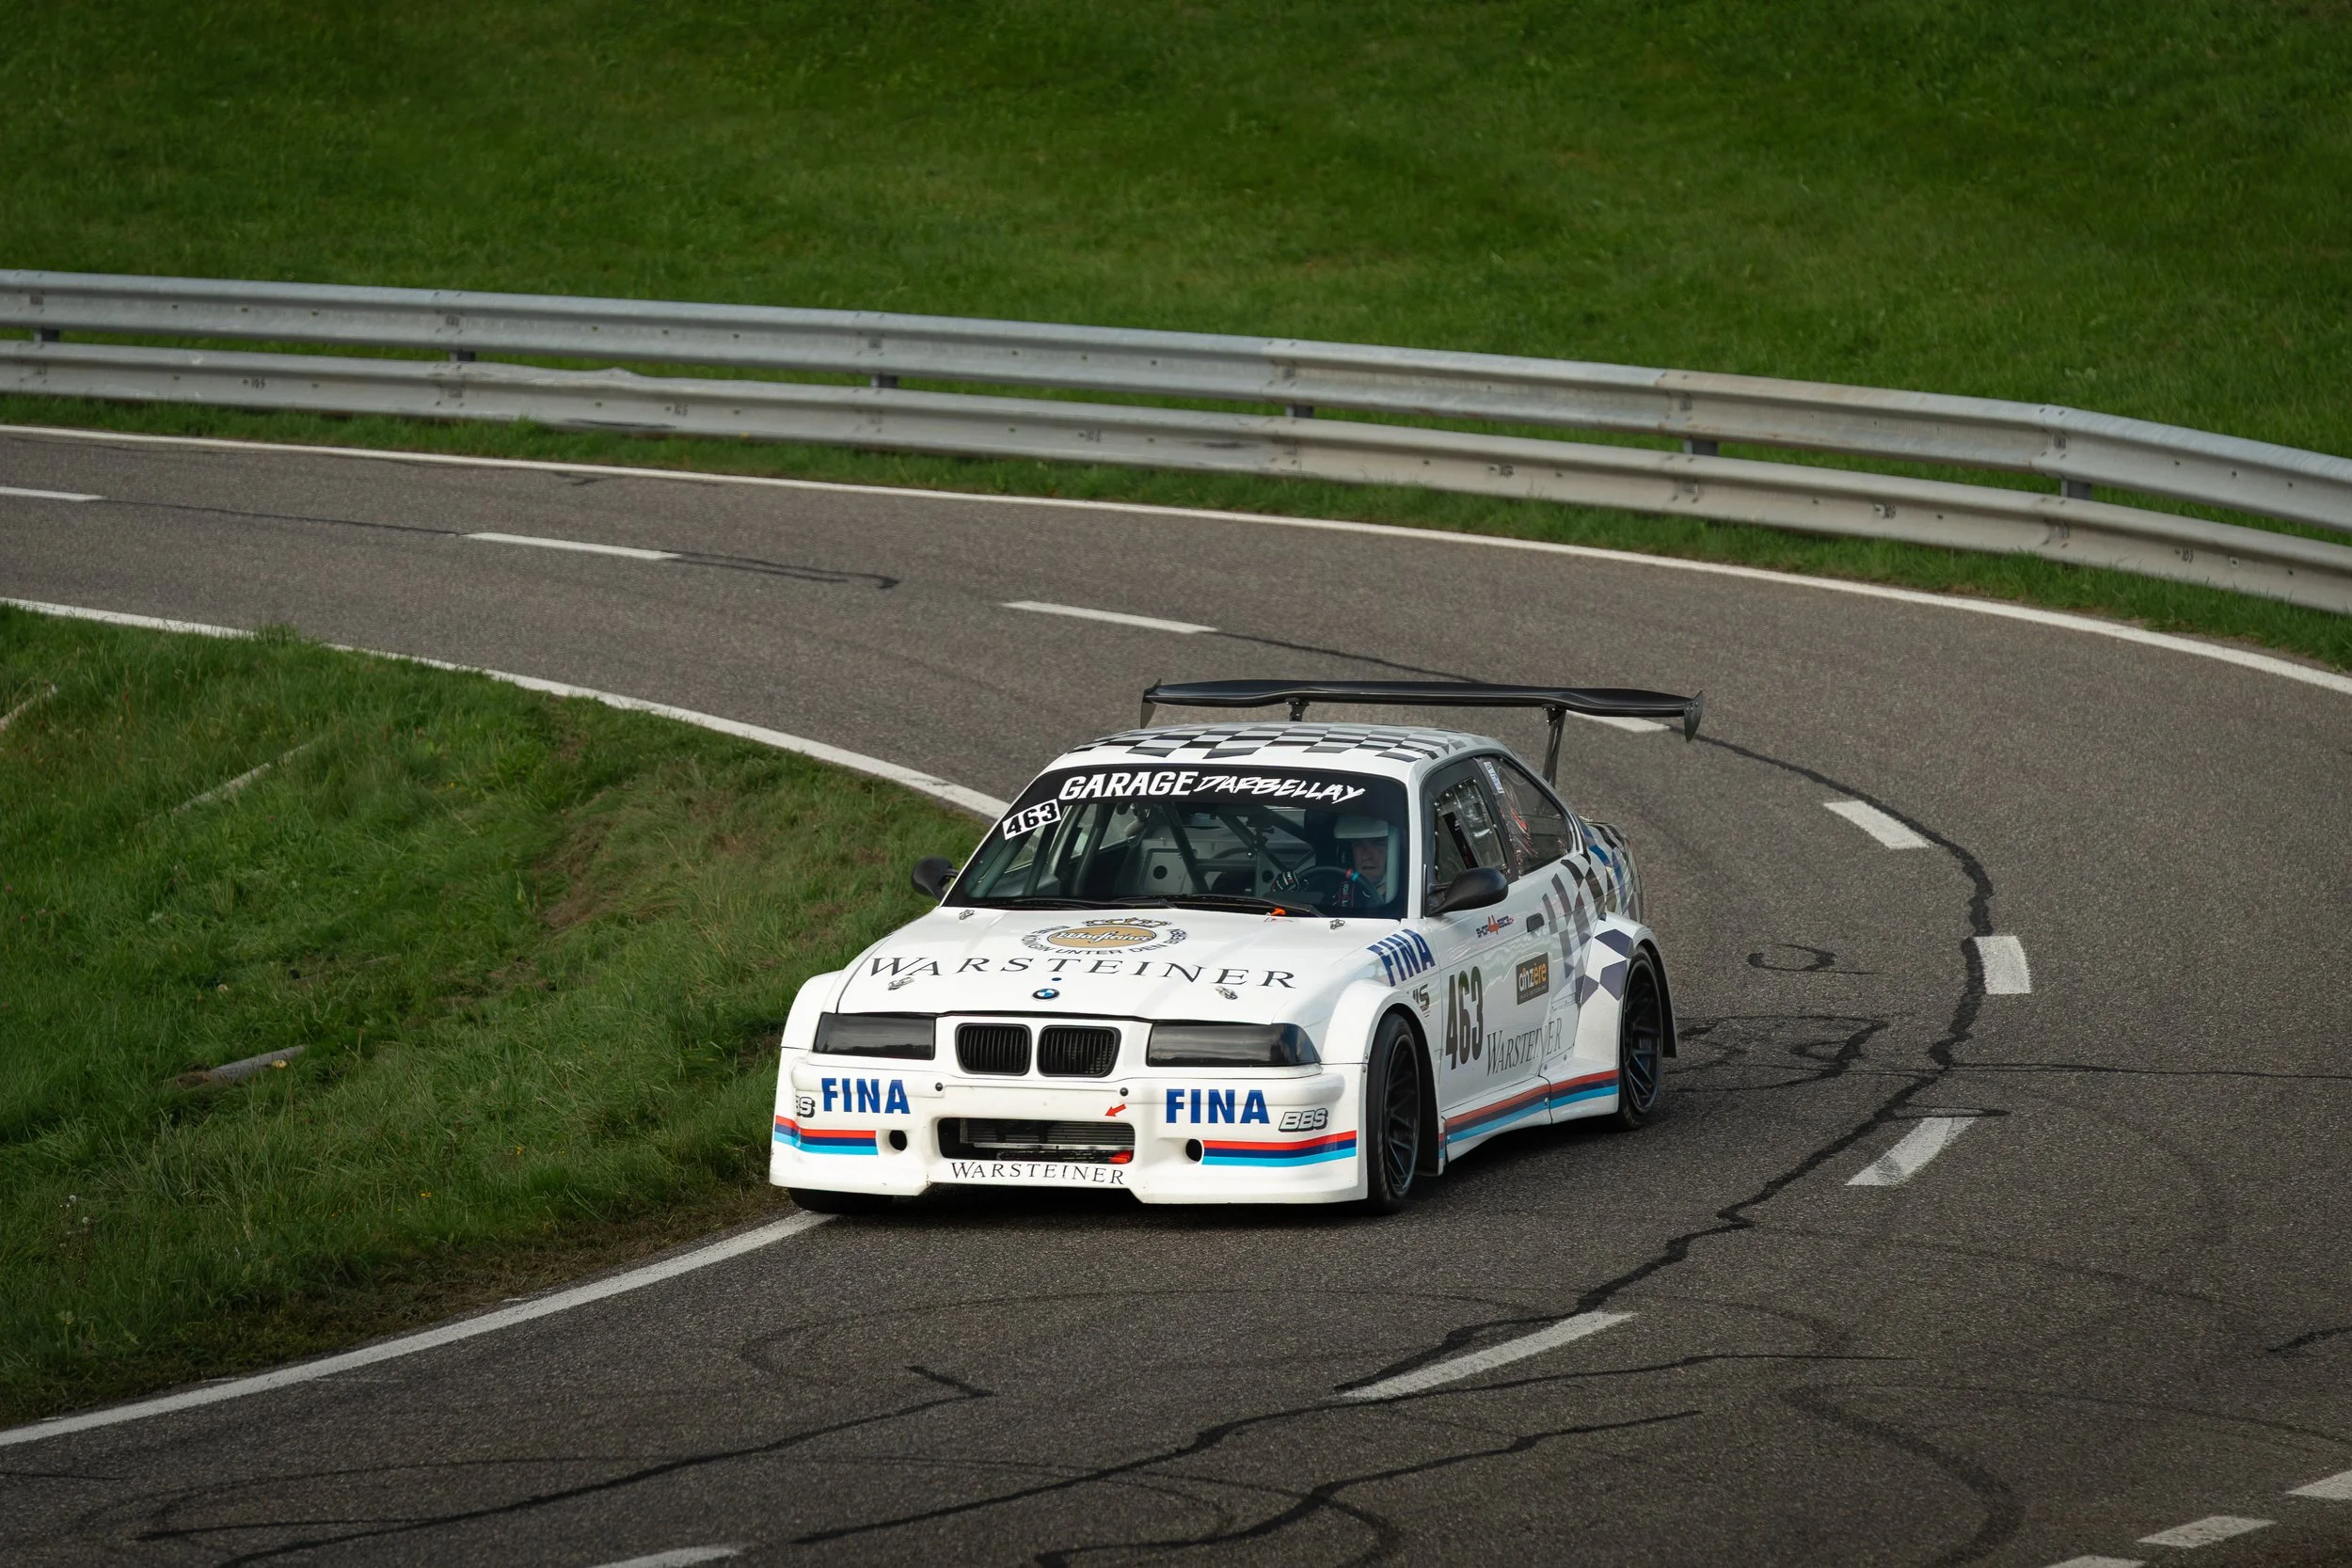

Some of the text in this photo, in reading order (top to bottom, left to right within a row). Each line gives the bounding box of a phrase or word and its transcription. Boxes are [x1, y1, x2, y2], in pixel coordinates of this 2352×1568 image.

[1058, 771, 1366, 803] GARAGE DARBELLAY
[1006, 802, 1058, 836] 463
[1128, 943, 1168, 953] DEN
[1366, 928, 1436, 987] FINA
[869, 957, 1297, 990] WARSTEINER
[1446, 966, 1484, 1070] 463
[821, 1078, 911, 1115] FINA
[1166, 1088, 1270, 1124] FINA
[1279, 1108, 1328, 1132] BBS
[950, 1162, 1125, 1185] WARSTEINER
